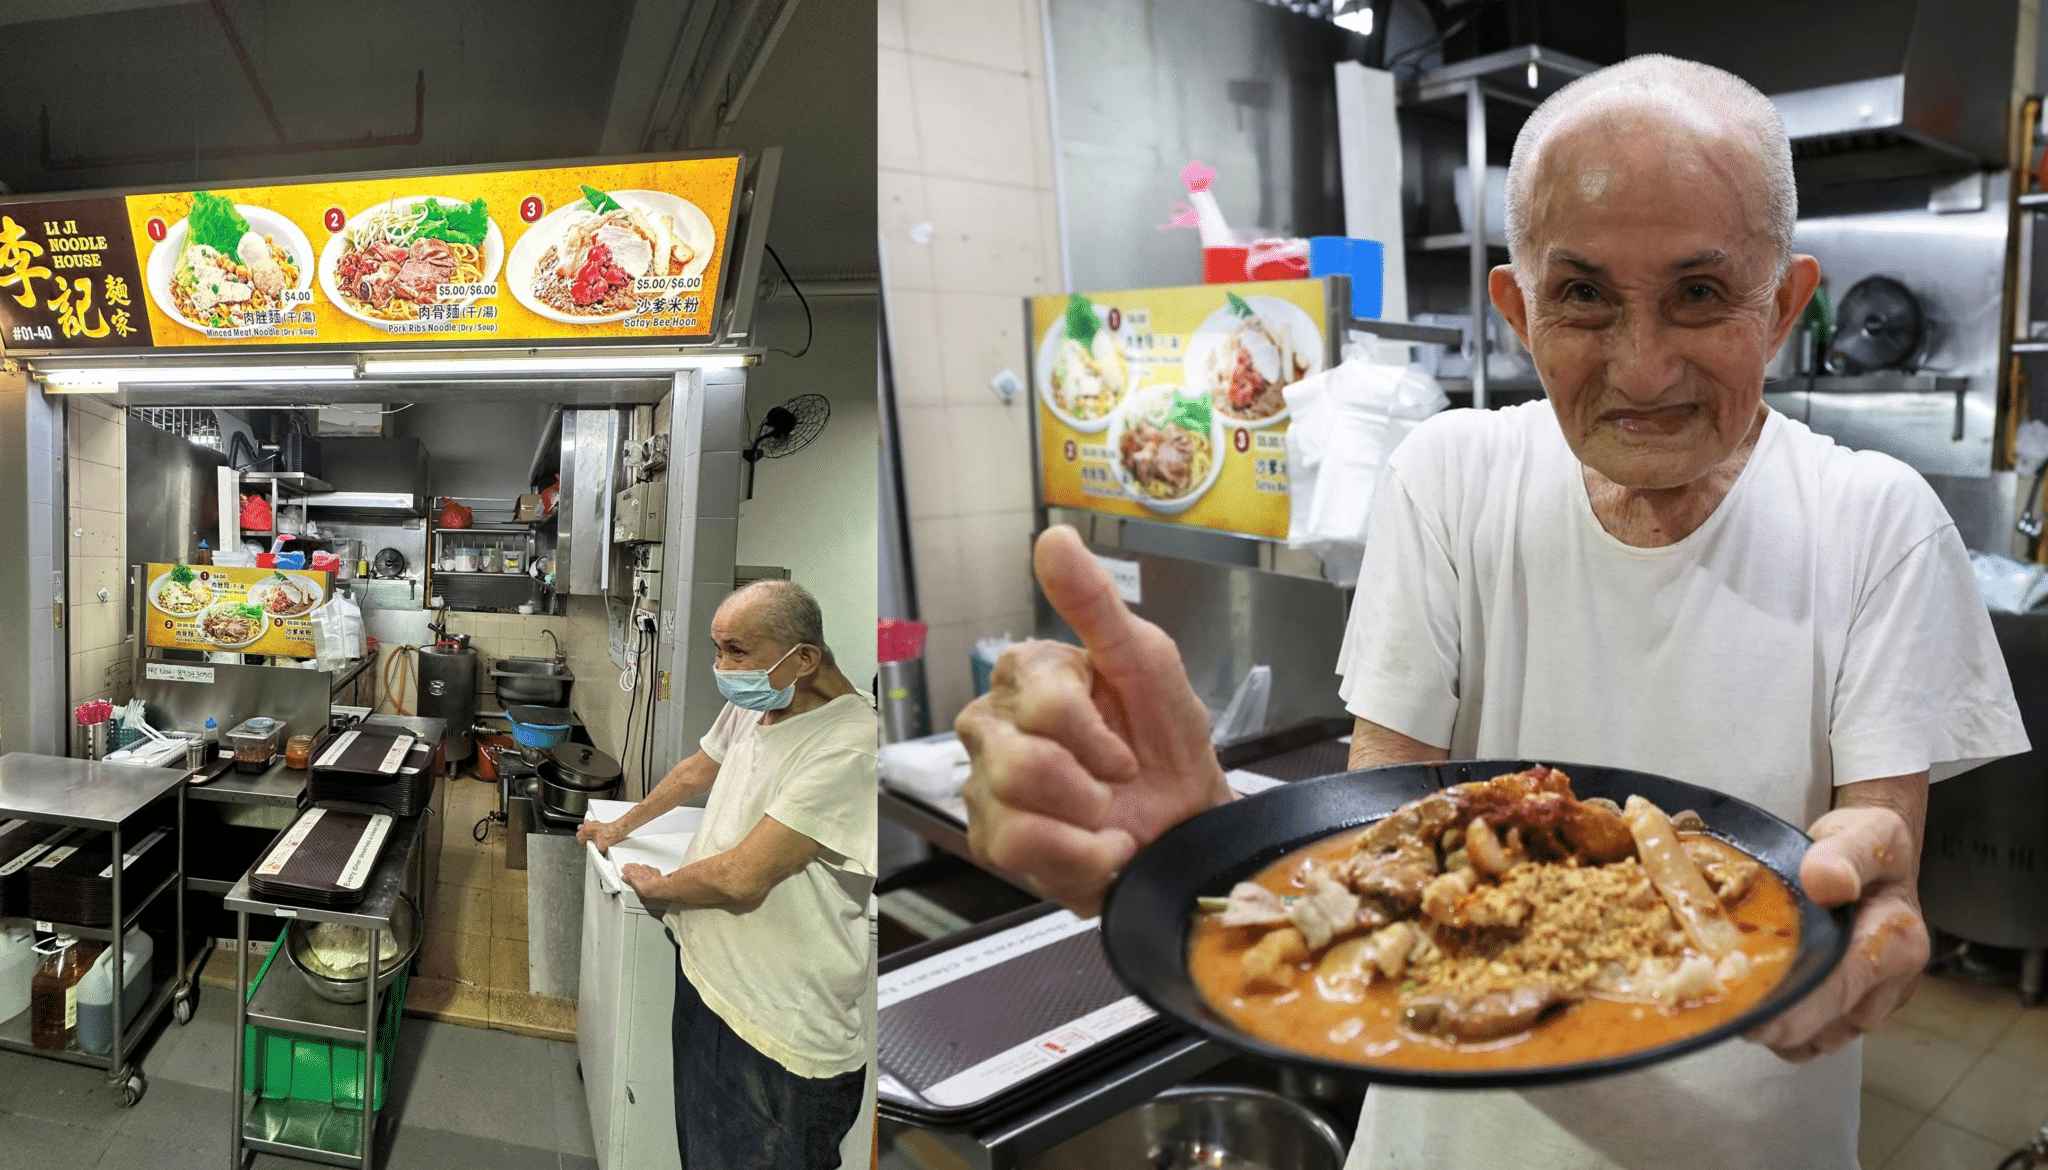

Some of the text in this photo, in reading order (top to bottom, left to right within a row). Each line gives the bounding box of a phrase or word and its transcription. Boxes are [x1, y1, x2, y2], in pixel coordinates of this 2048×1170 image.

[44, 220, 78, 236] LI JI
[48, 236, 108, 252] NOODLE
[52, 253, 102, 269] HOUSE
[636, 277, 701, 290] $5.00/$6.00
[284, 291, 311, 302] $4.00
[439, 285, 497, 296] $5.00/$6.00
[636, 296, 699, 314] 沙爹米粉
[388, 324, 407, 333] Pork
[409, 323, 426, 332] Ribs
[428, 323, 456, 332] Noodle
[624, 317, 697, 328] Satay Bee Hoon
[12, 325, 53, 341] #01-40
[206, 329, 232, 338] Minced
[233, 328, 252, 337] Meat
[253, 327, 280, 336] Noodle
